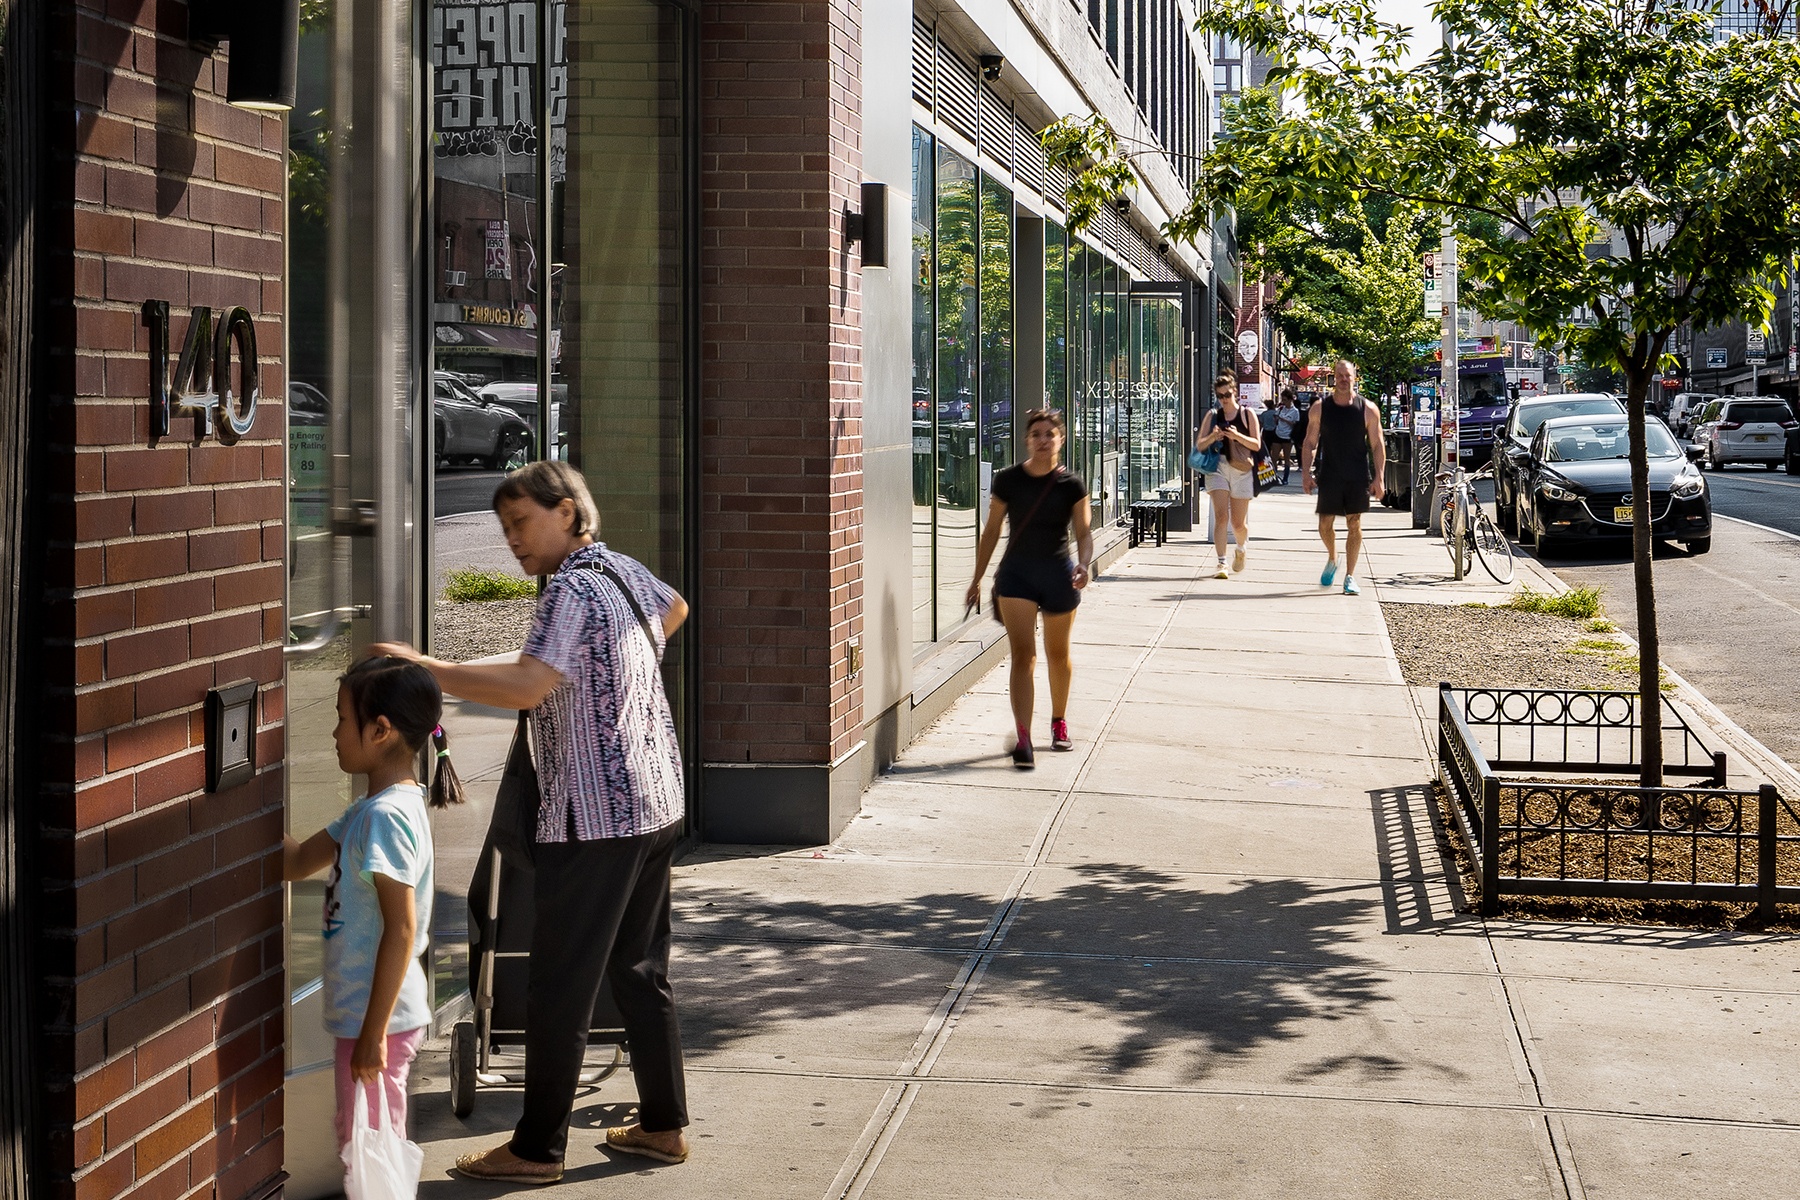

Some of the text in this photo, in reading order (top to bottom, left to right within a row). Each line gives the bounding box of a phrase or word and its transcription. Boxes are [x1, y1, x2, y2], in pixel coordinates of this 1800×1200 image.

[1749, 333, 1763, 342] 25
[141, 299, 259, 436] 140
[1507, 378, 1539, 391] edEx
[296, 431, 325, 441] Energy
[301, 441, 327, 451] Rating
[301, 460, 315, 471] 89
